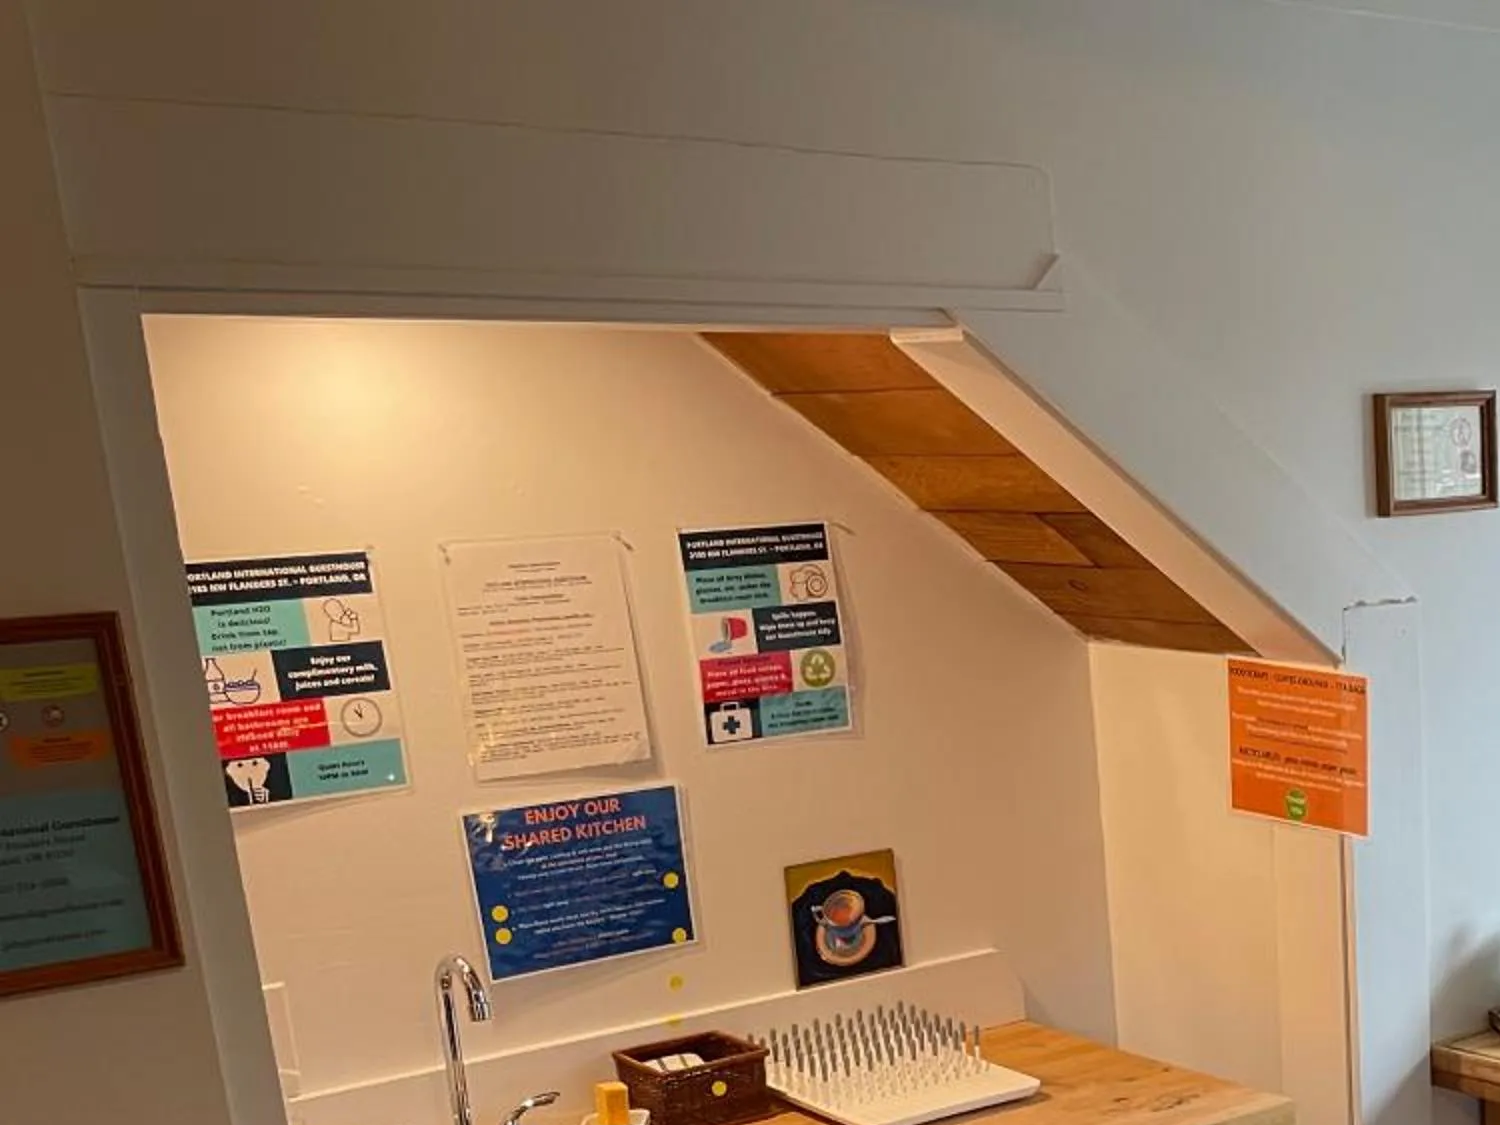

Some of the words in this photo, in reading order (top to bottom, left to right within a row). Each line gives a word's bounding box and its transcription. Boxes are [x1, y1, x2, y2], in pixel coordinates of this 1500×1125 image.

[187, 571, 232, 583] ORTLAND
[233, 565, 307, 580] INTERNATIONAL
[524, 803, 580, 826] ENJOY
[584, 797, 621, 816] OUR
[502, 826, 573, 852] SHARED
[576, 815, 647, 841] KITCHEN
